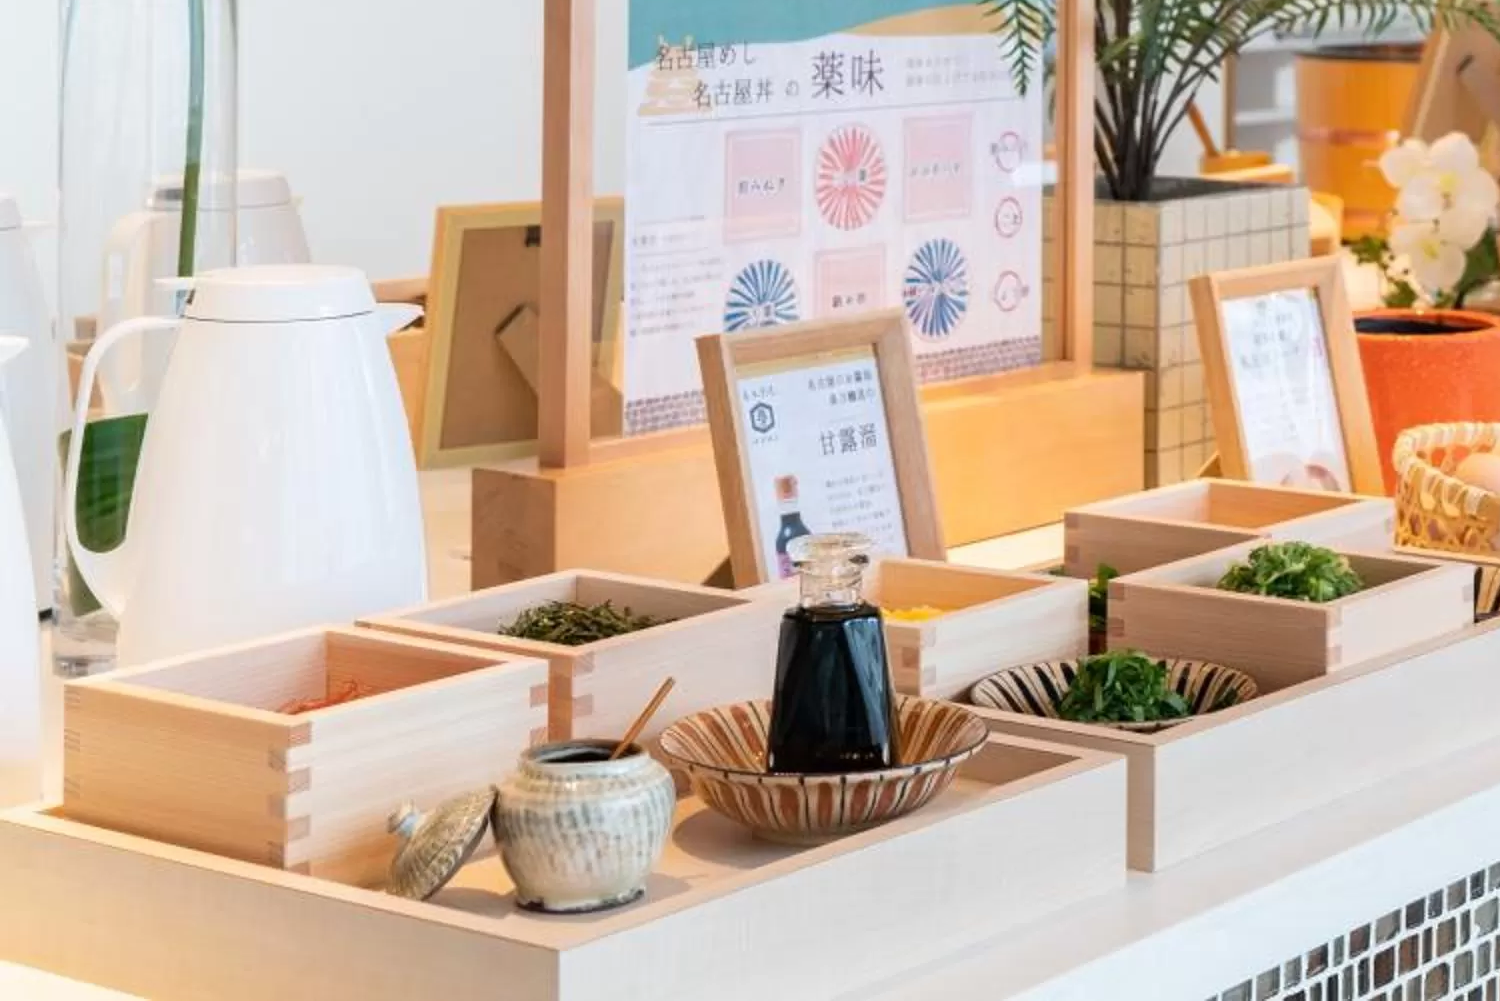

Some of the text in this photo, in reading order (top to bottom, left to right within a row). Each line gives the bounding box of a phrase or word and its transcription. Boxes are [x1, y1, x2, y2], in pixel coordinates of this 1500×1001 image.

[655, 40, 757, 72] 名古屋めし
[785, 79, 800, 97] の
[811, 49, 885, 100] 薬味
